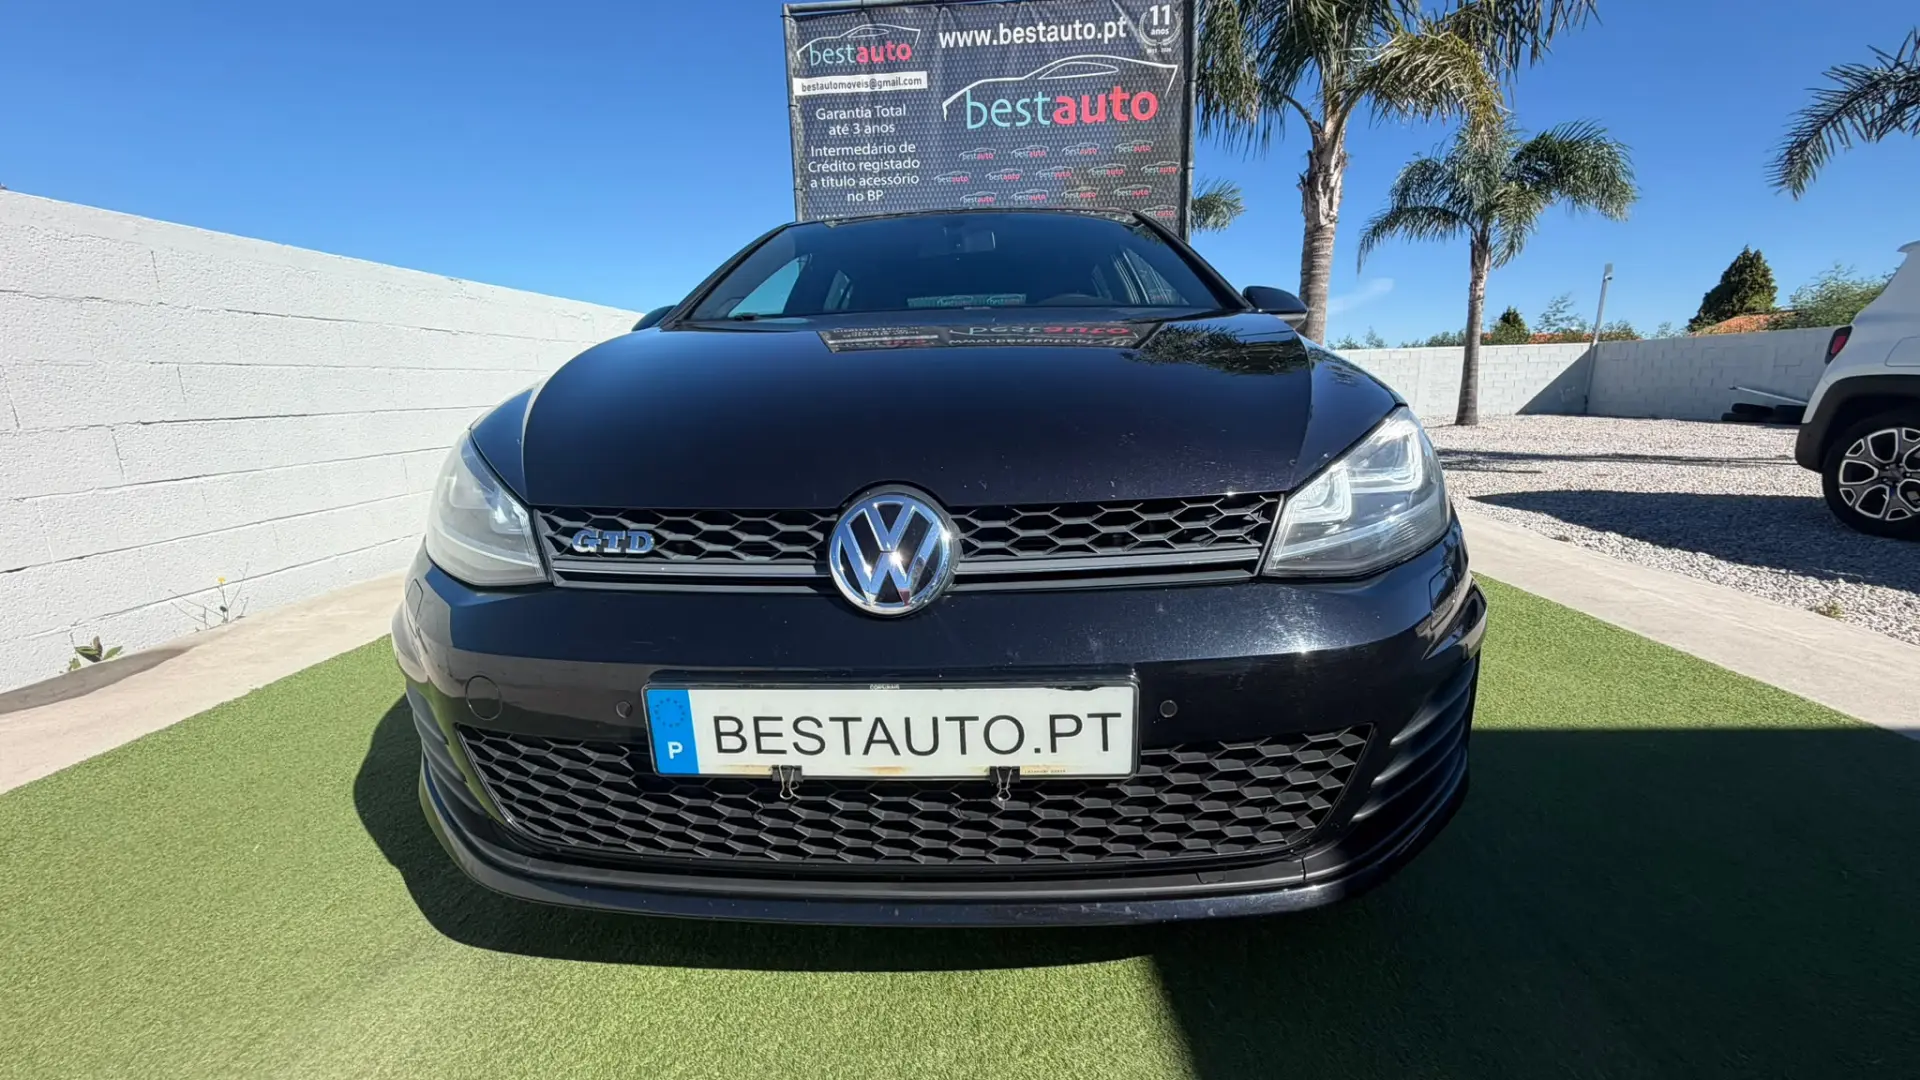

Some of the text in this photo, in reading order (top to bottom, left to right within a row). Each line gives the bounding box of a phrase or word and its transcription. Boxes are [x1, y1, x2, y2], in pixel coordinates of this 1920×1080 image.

[1150, 4, 1170, 26] 11
[939, 16, 1127, 48] www.bestauto.pt
[1150, 28, 1170, 36] anos
[809, 41, 912, 66] bestauto
[801, 76, 923, 92] bestautomoveis@gmail.com
[815, 104, 906, 121] Garantia Total
[966, 85, 1159, 129] bestauto
[828, 123, 895, 136] até 3 anos
[810, 141, 916, 157] Intermedário de
[808, 157, 921, 173] Crédito registado
[810, 174, 919, 188] a título acessório
[846, 190, 884, 202] no BP
[571, 529, 655, 554] GTD
[712, 712, 1122, 757] BESTAUTO.PT
[668, 741, 683, 759] P
